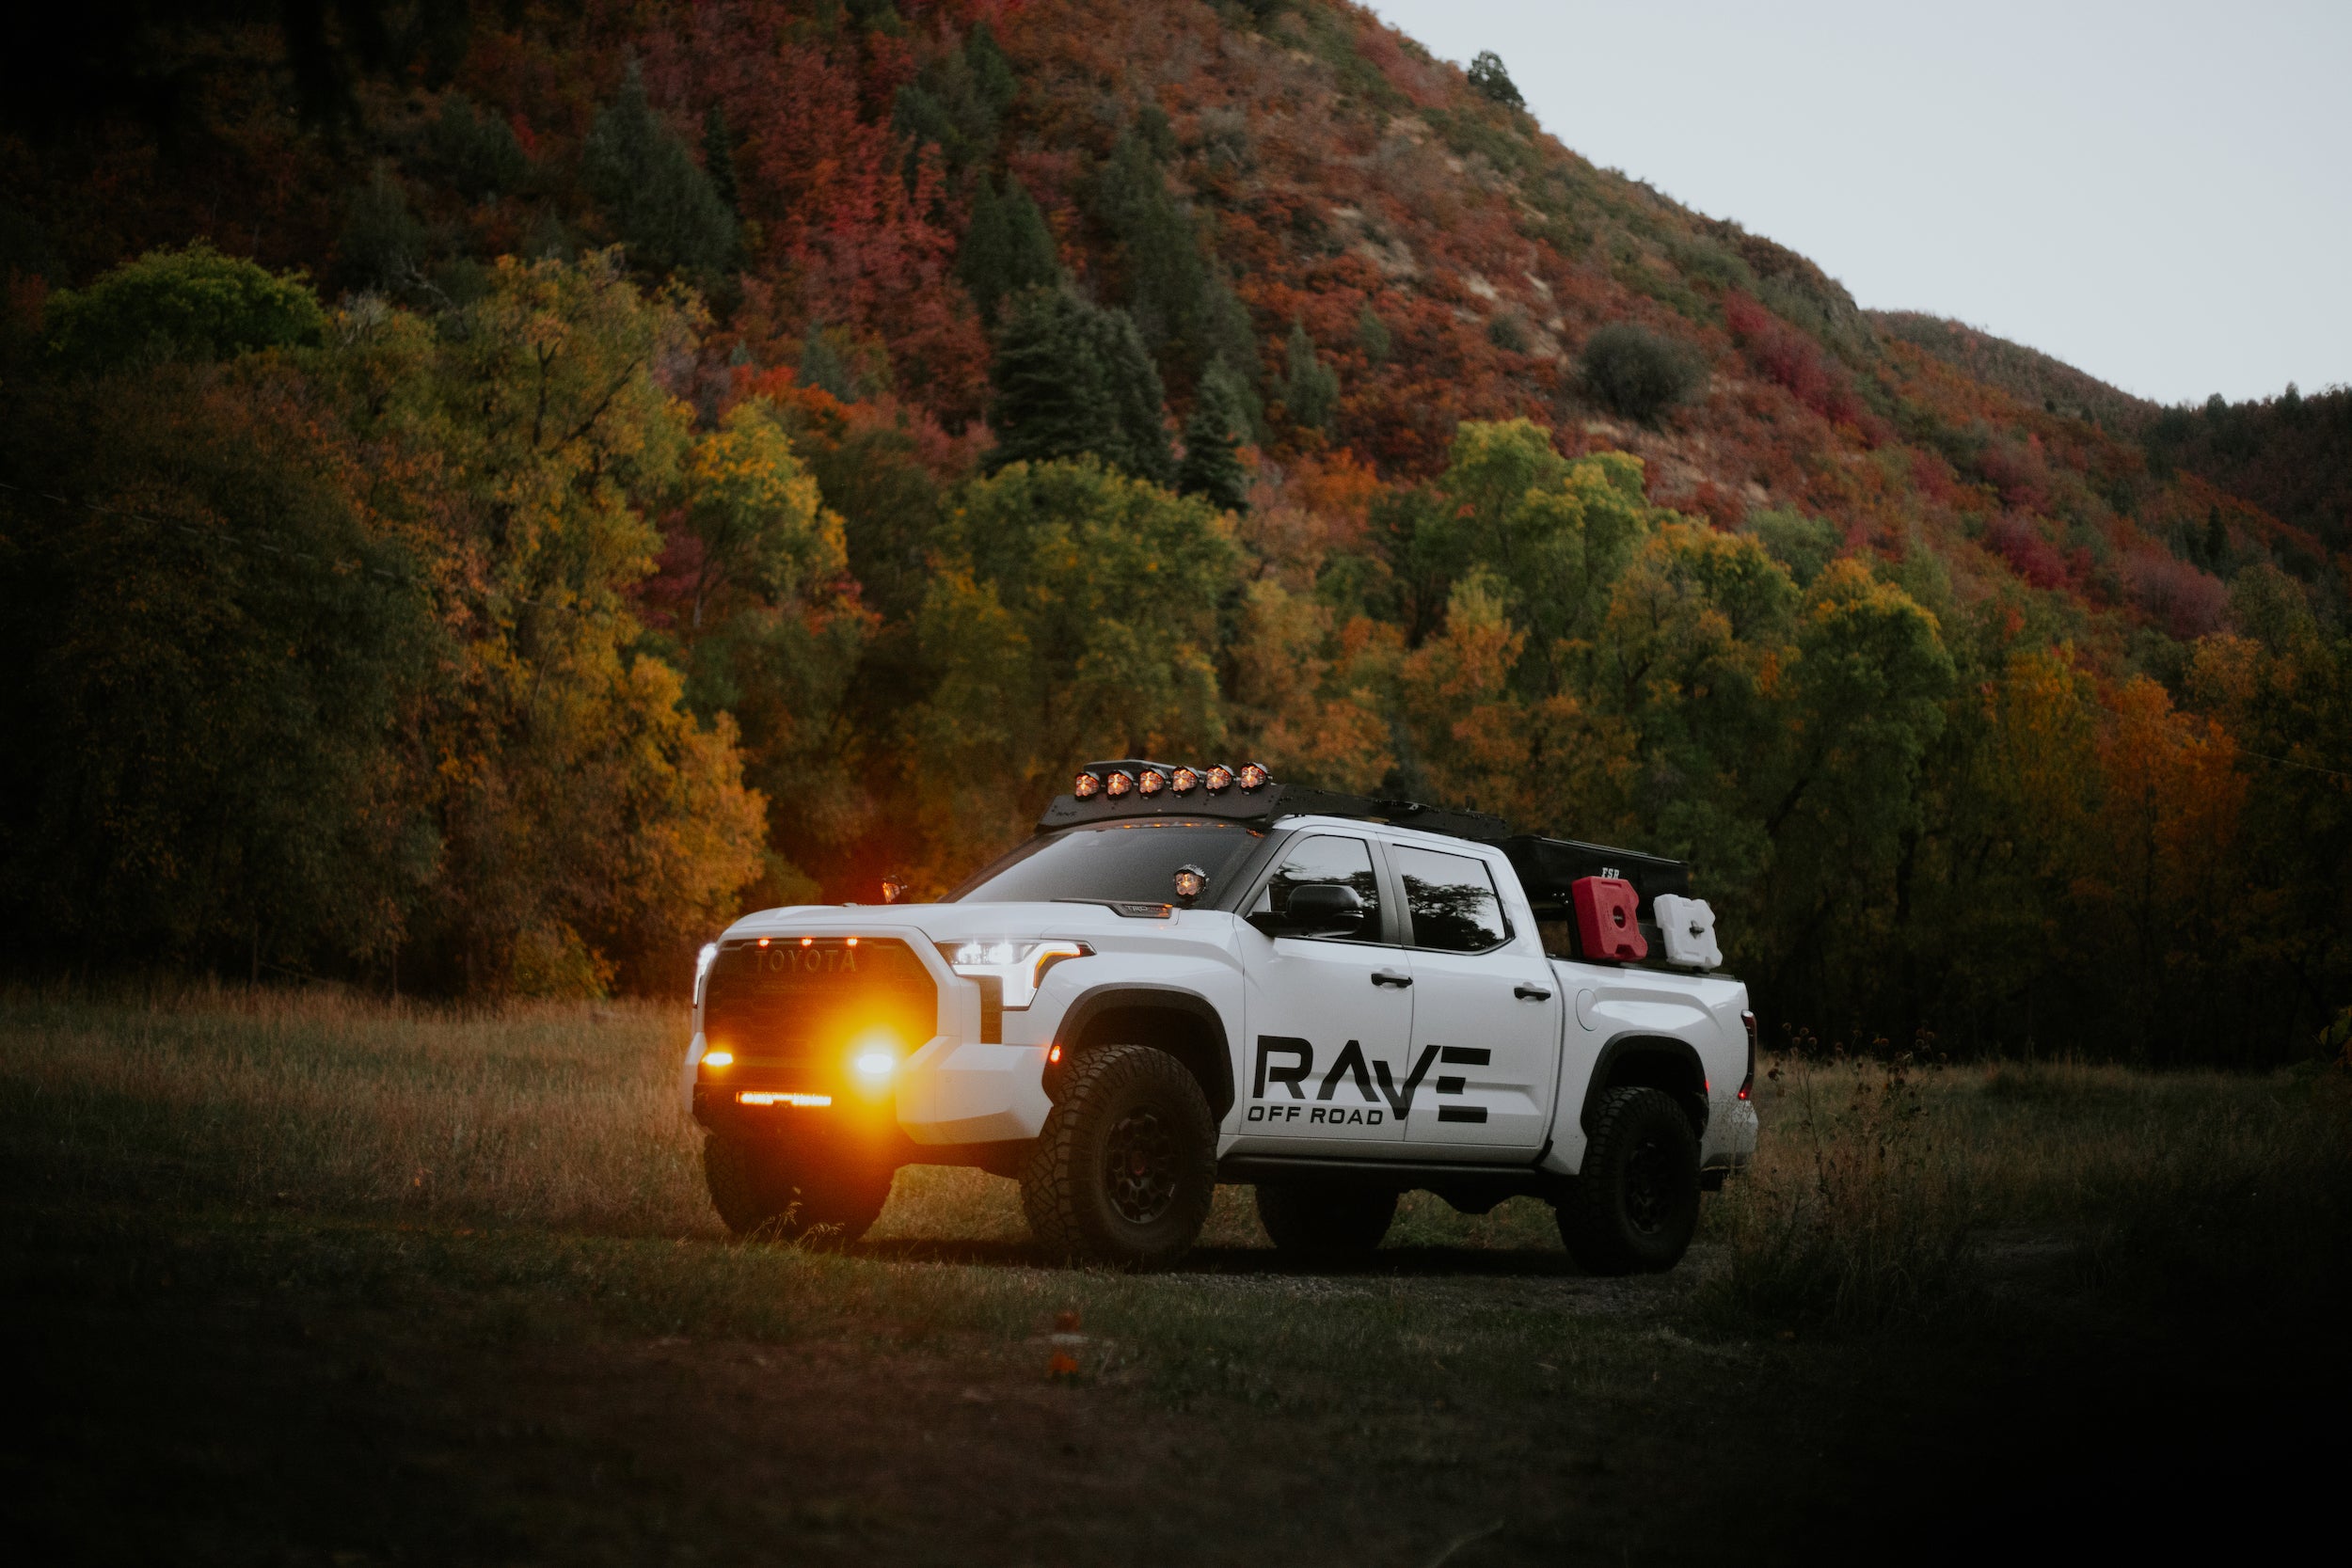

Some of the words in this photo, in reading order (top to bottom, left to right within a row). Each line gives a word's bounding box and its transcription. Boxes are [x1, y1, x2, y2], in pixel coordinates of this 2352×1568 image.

[1601, 866, 1619, 879] FSR
[755, 948, 856, 974] TOYOTA
[1252, 1035, 1491, 1123] RAVE
[1248, 1105, 1301, 1122] OFF
[1310, 1107, 1384, 1125] ROAD
